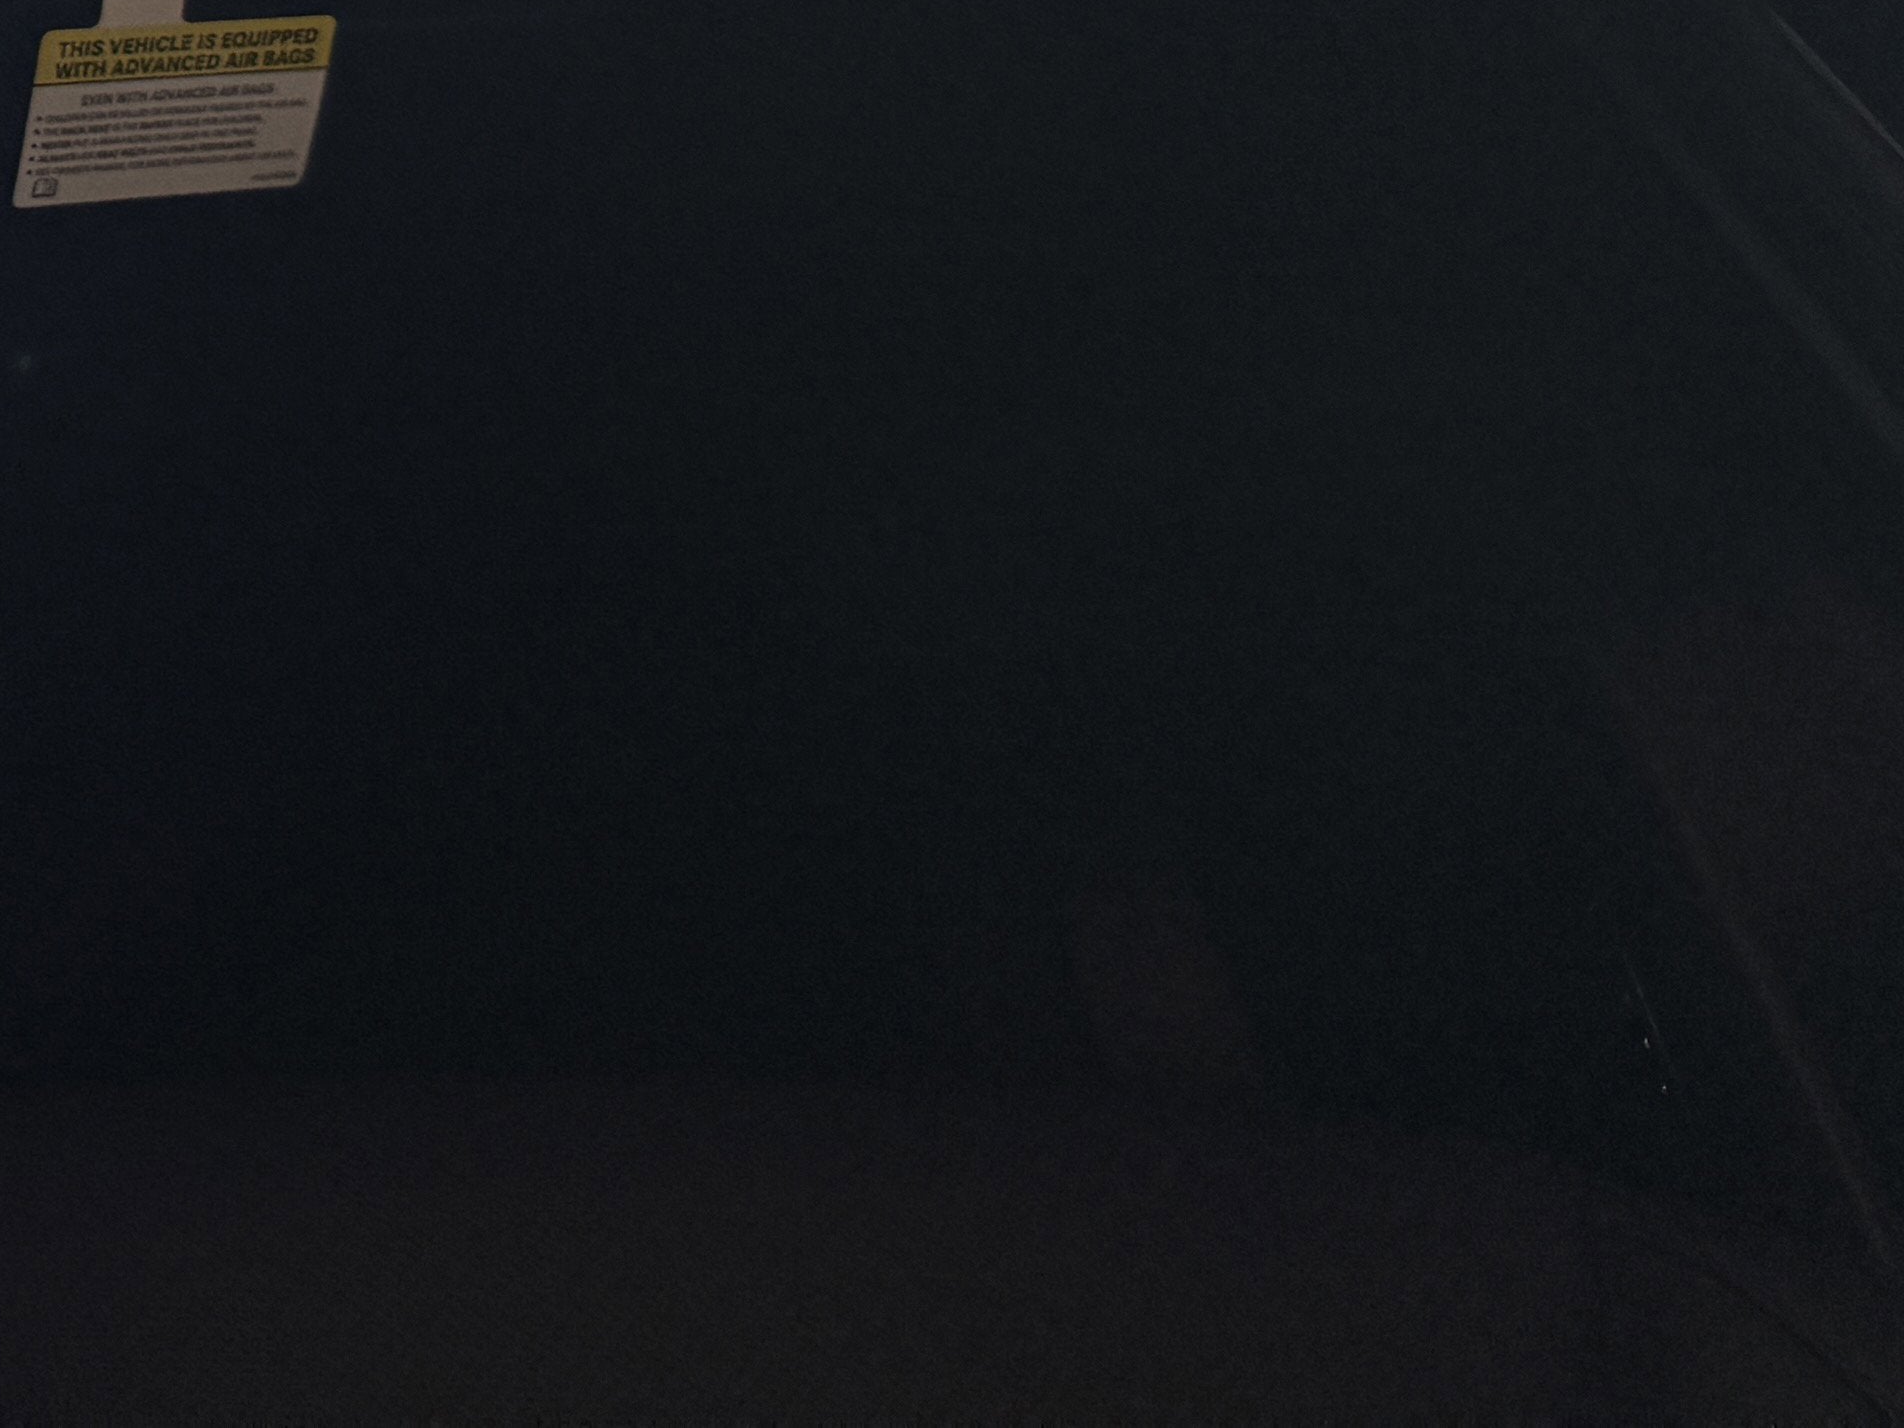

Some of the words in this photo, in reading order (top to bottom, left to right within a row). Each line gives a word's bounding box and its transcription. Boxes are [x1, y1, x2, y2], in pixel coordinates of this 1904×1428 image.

[59, 40, 104, 58] THIS
[110, 34, 193, 55] VEHICLE
[195, 32, 216, 49] IS
[220, 27, 319, 47] EQUIPPED
[55, 60, 106, 79] WITH
[111, 54, 220, 76] ADVANCED
[225, 51, 258, 69] AIR
[262, 48, 316, 66] BAGS
